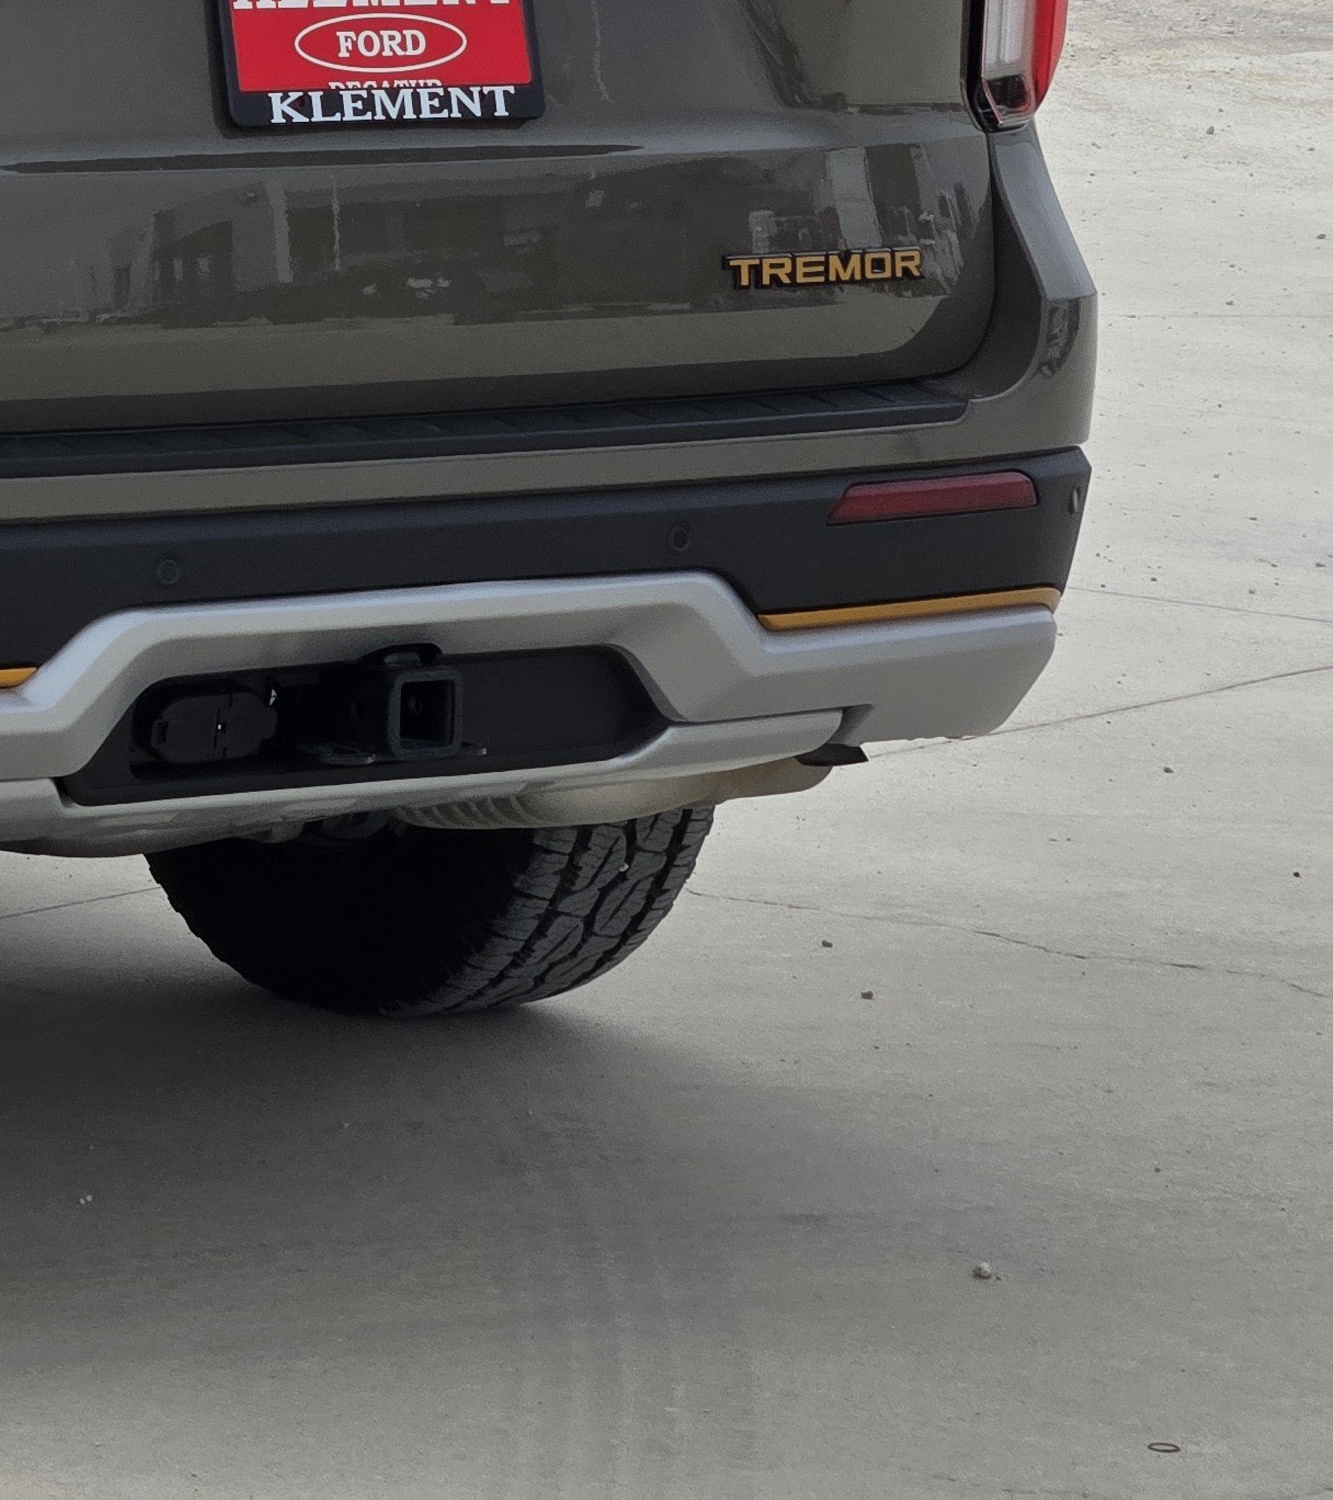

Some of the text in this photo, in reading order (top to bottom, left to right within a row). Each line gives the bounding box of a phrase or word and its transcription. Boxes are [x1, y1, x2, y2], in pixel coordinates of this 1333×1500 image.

[335, 29, 427, 58] FORD
[267, 85, 515, 124] KLEMENT
[724, 247, 924, 288] TREMOR
